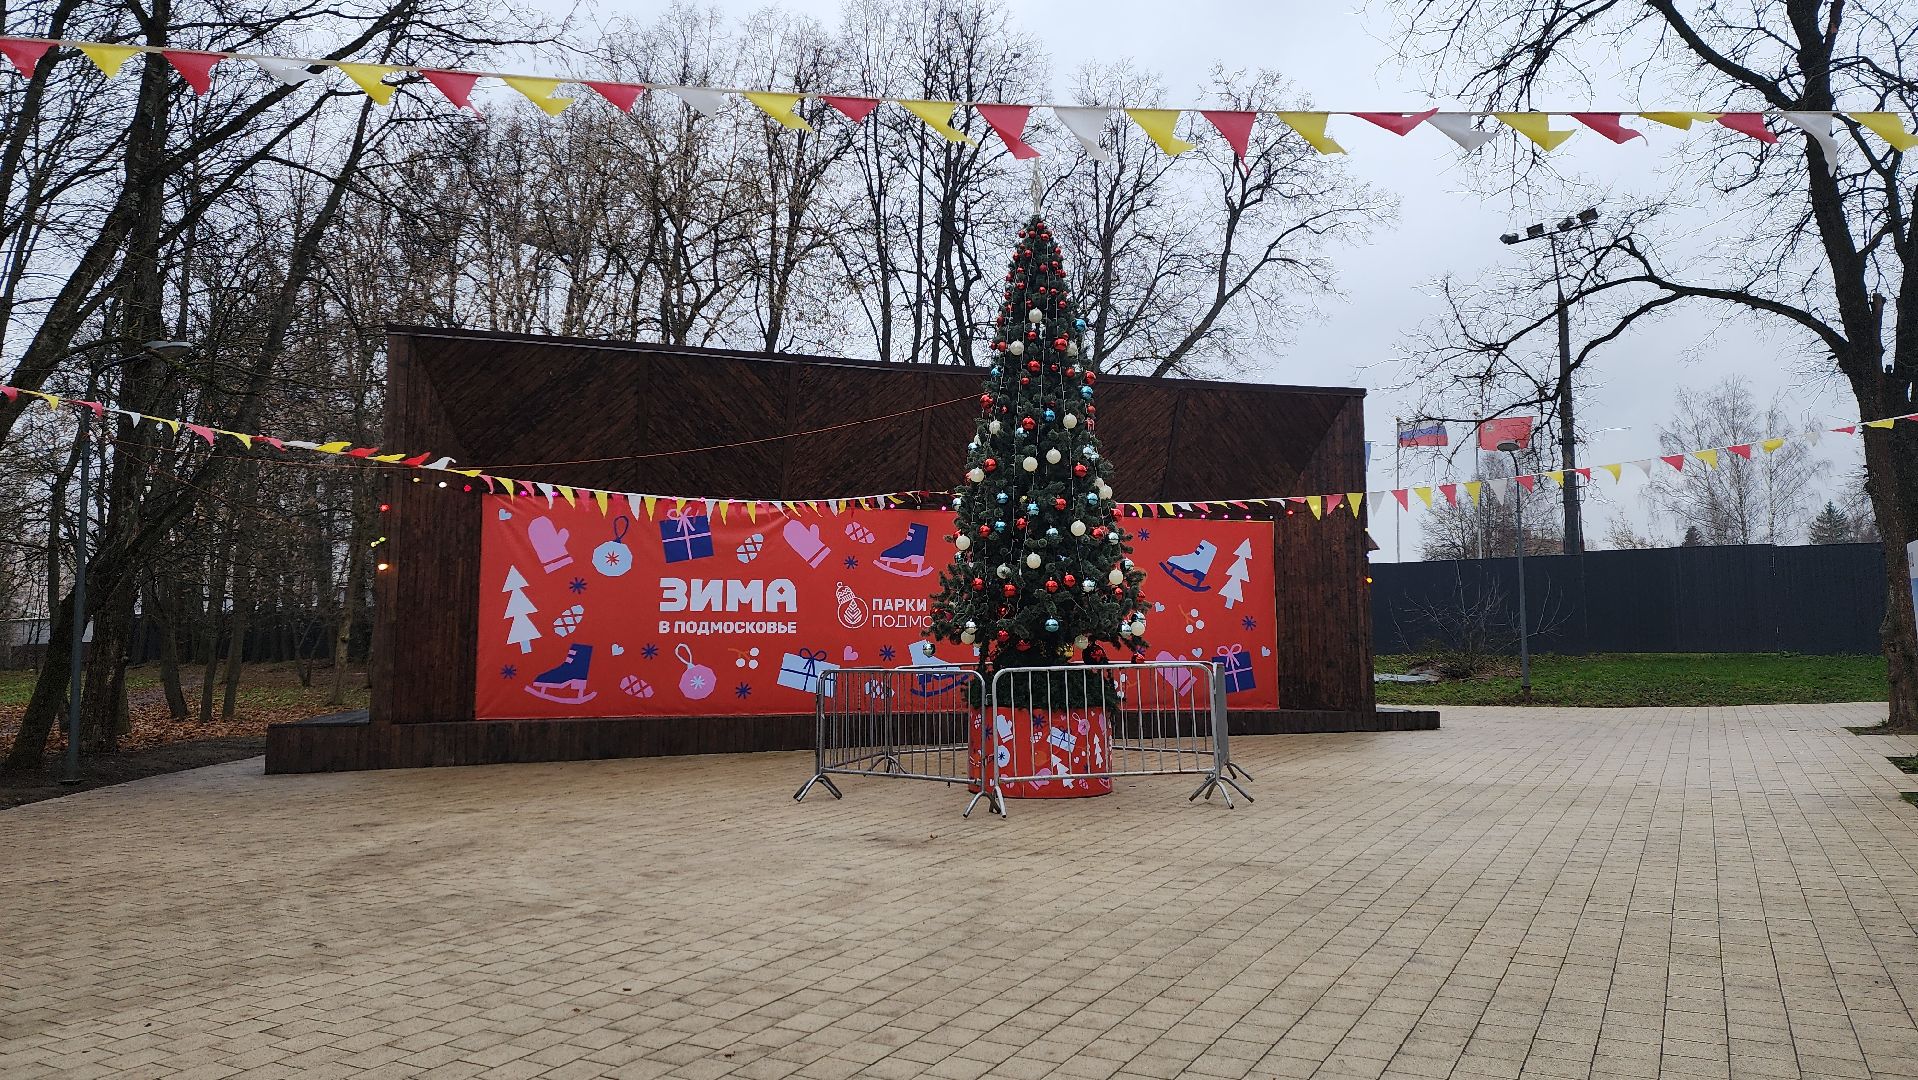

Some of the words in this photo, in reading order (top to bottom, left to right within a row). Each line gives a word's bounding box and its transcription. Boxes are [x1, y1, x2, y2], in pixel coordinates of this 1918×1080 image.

[659, 577, 798, 613] ЗИМА
[872, 598, 927, 612] ПАРКИ
[658, 620, 670, 634] В
[673, 620, 797, 636] ПОДМОСКОВЬЕ
[872, 614, 934, 628] ПОДМО
